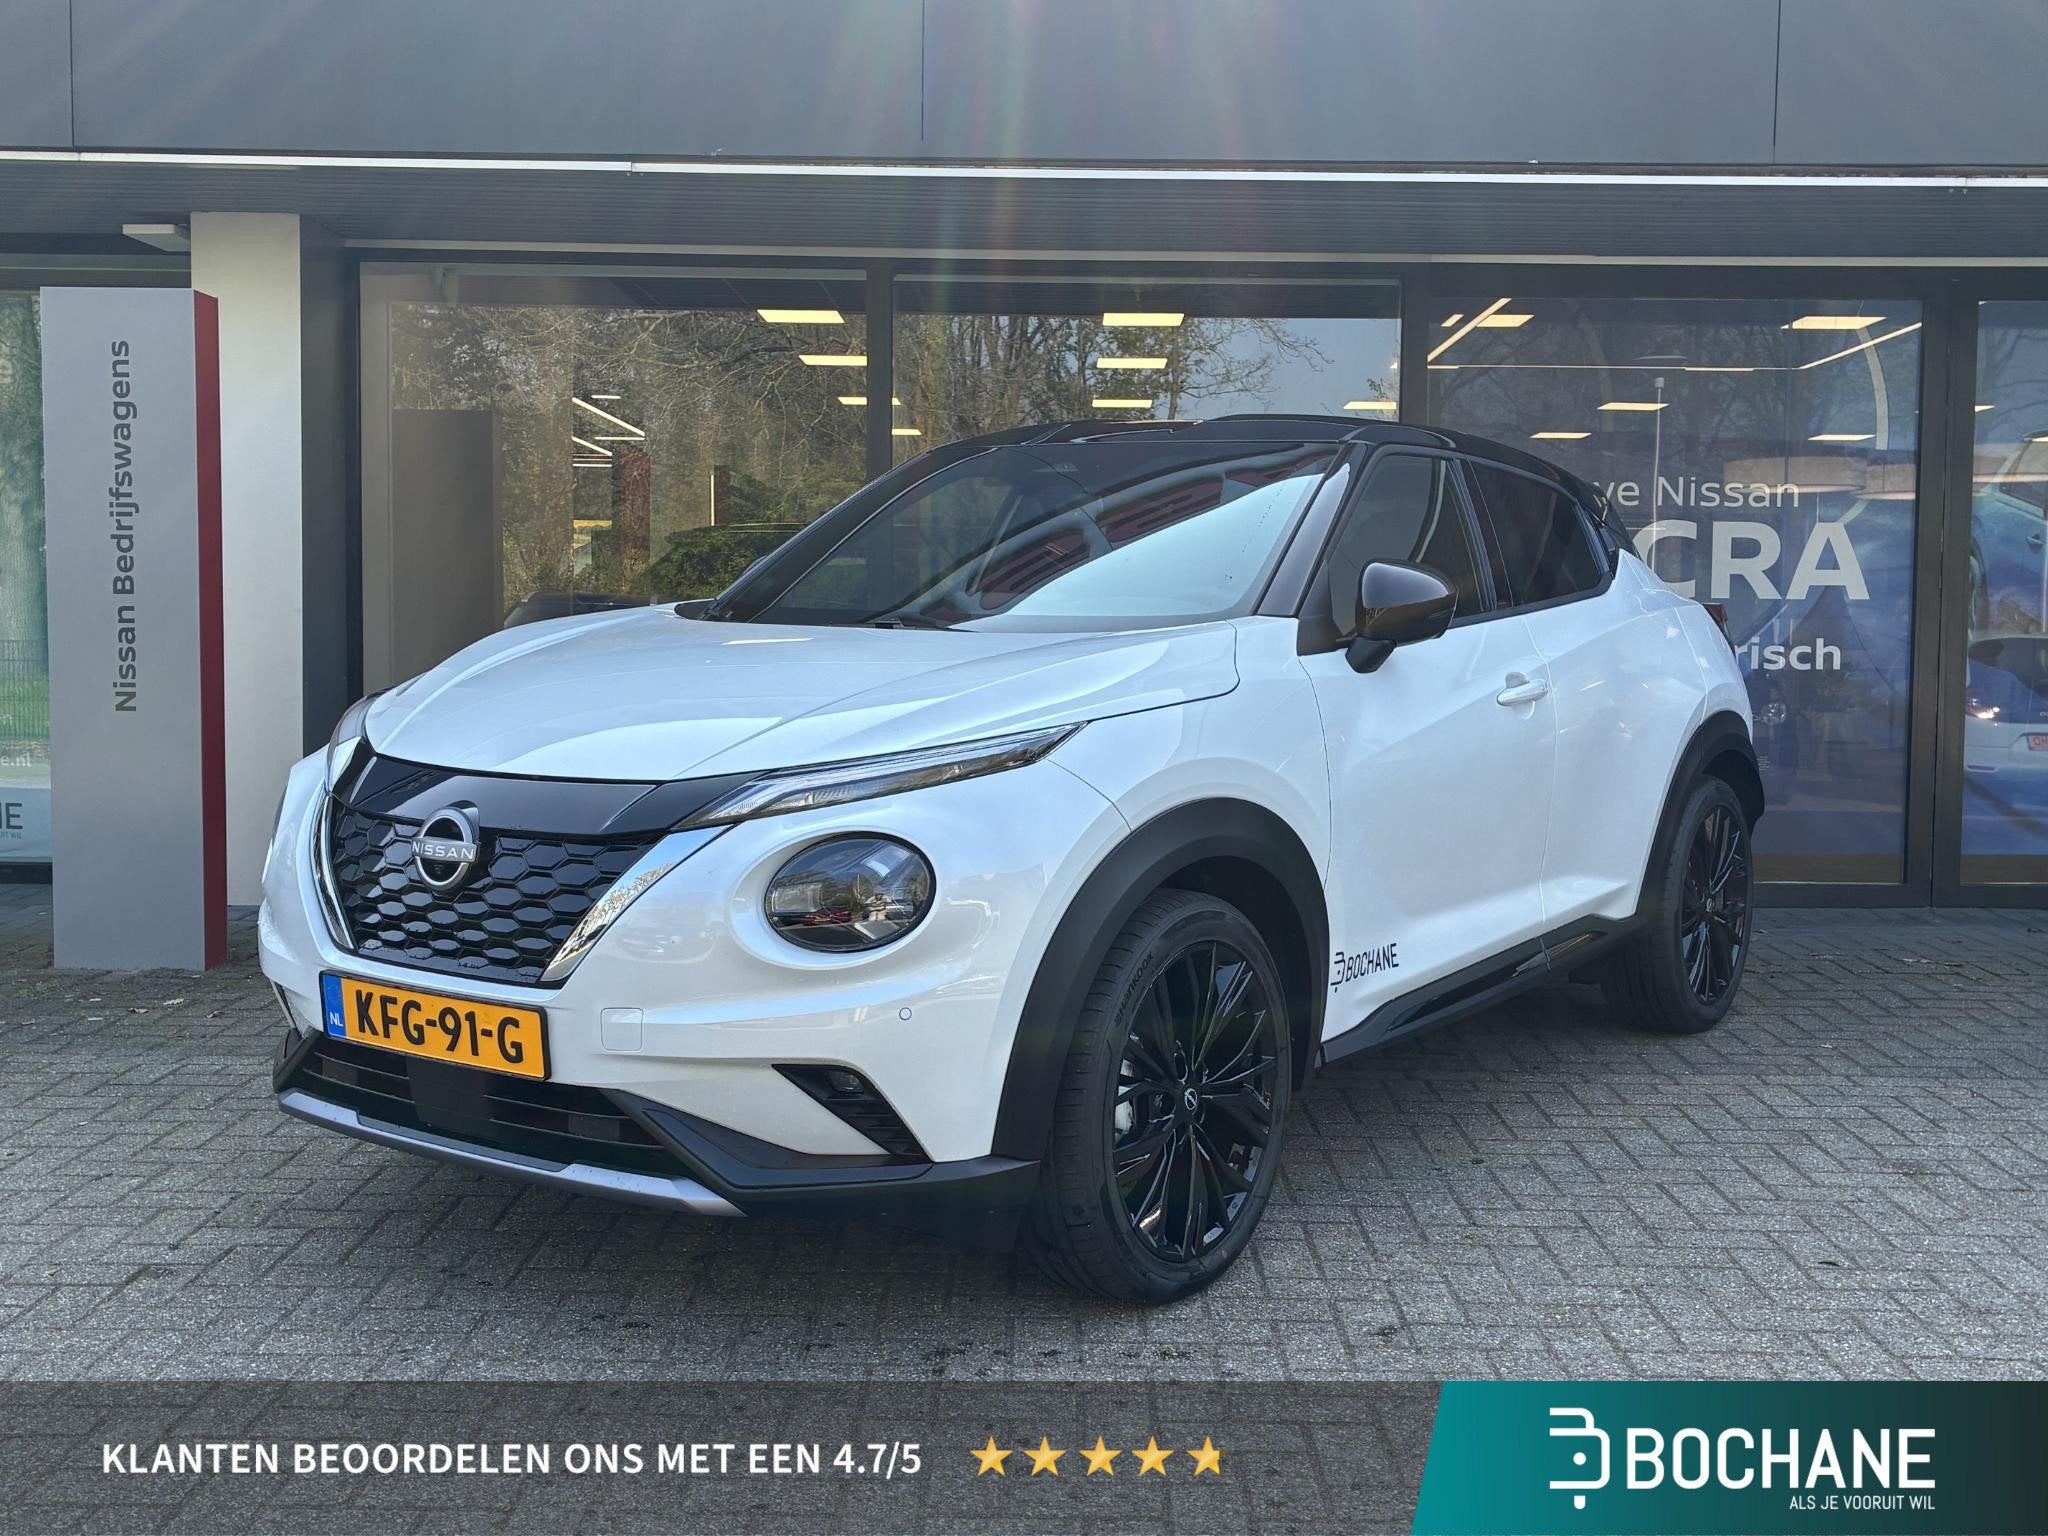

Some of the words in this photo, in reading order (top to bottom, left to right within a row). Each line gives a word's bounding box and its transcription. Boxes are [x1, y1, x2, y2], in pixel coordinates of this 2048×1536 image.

[109, 339, 140, 595] Bedrijfswagens
[1656, 476, 1800, 508] Nissan
[112, 605, 138, 712] Nissan
[0, 802, 24, 830] E
[412, 842, 475, 860] NISSAN
[1345, 942, 1400, 983] BOCHANE
[329, 1011, 344, 1028] NL
[355, 989, 525, 1065] KFG-91-G
